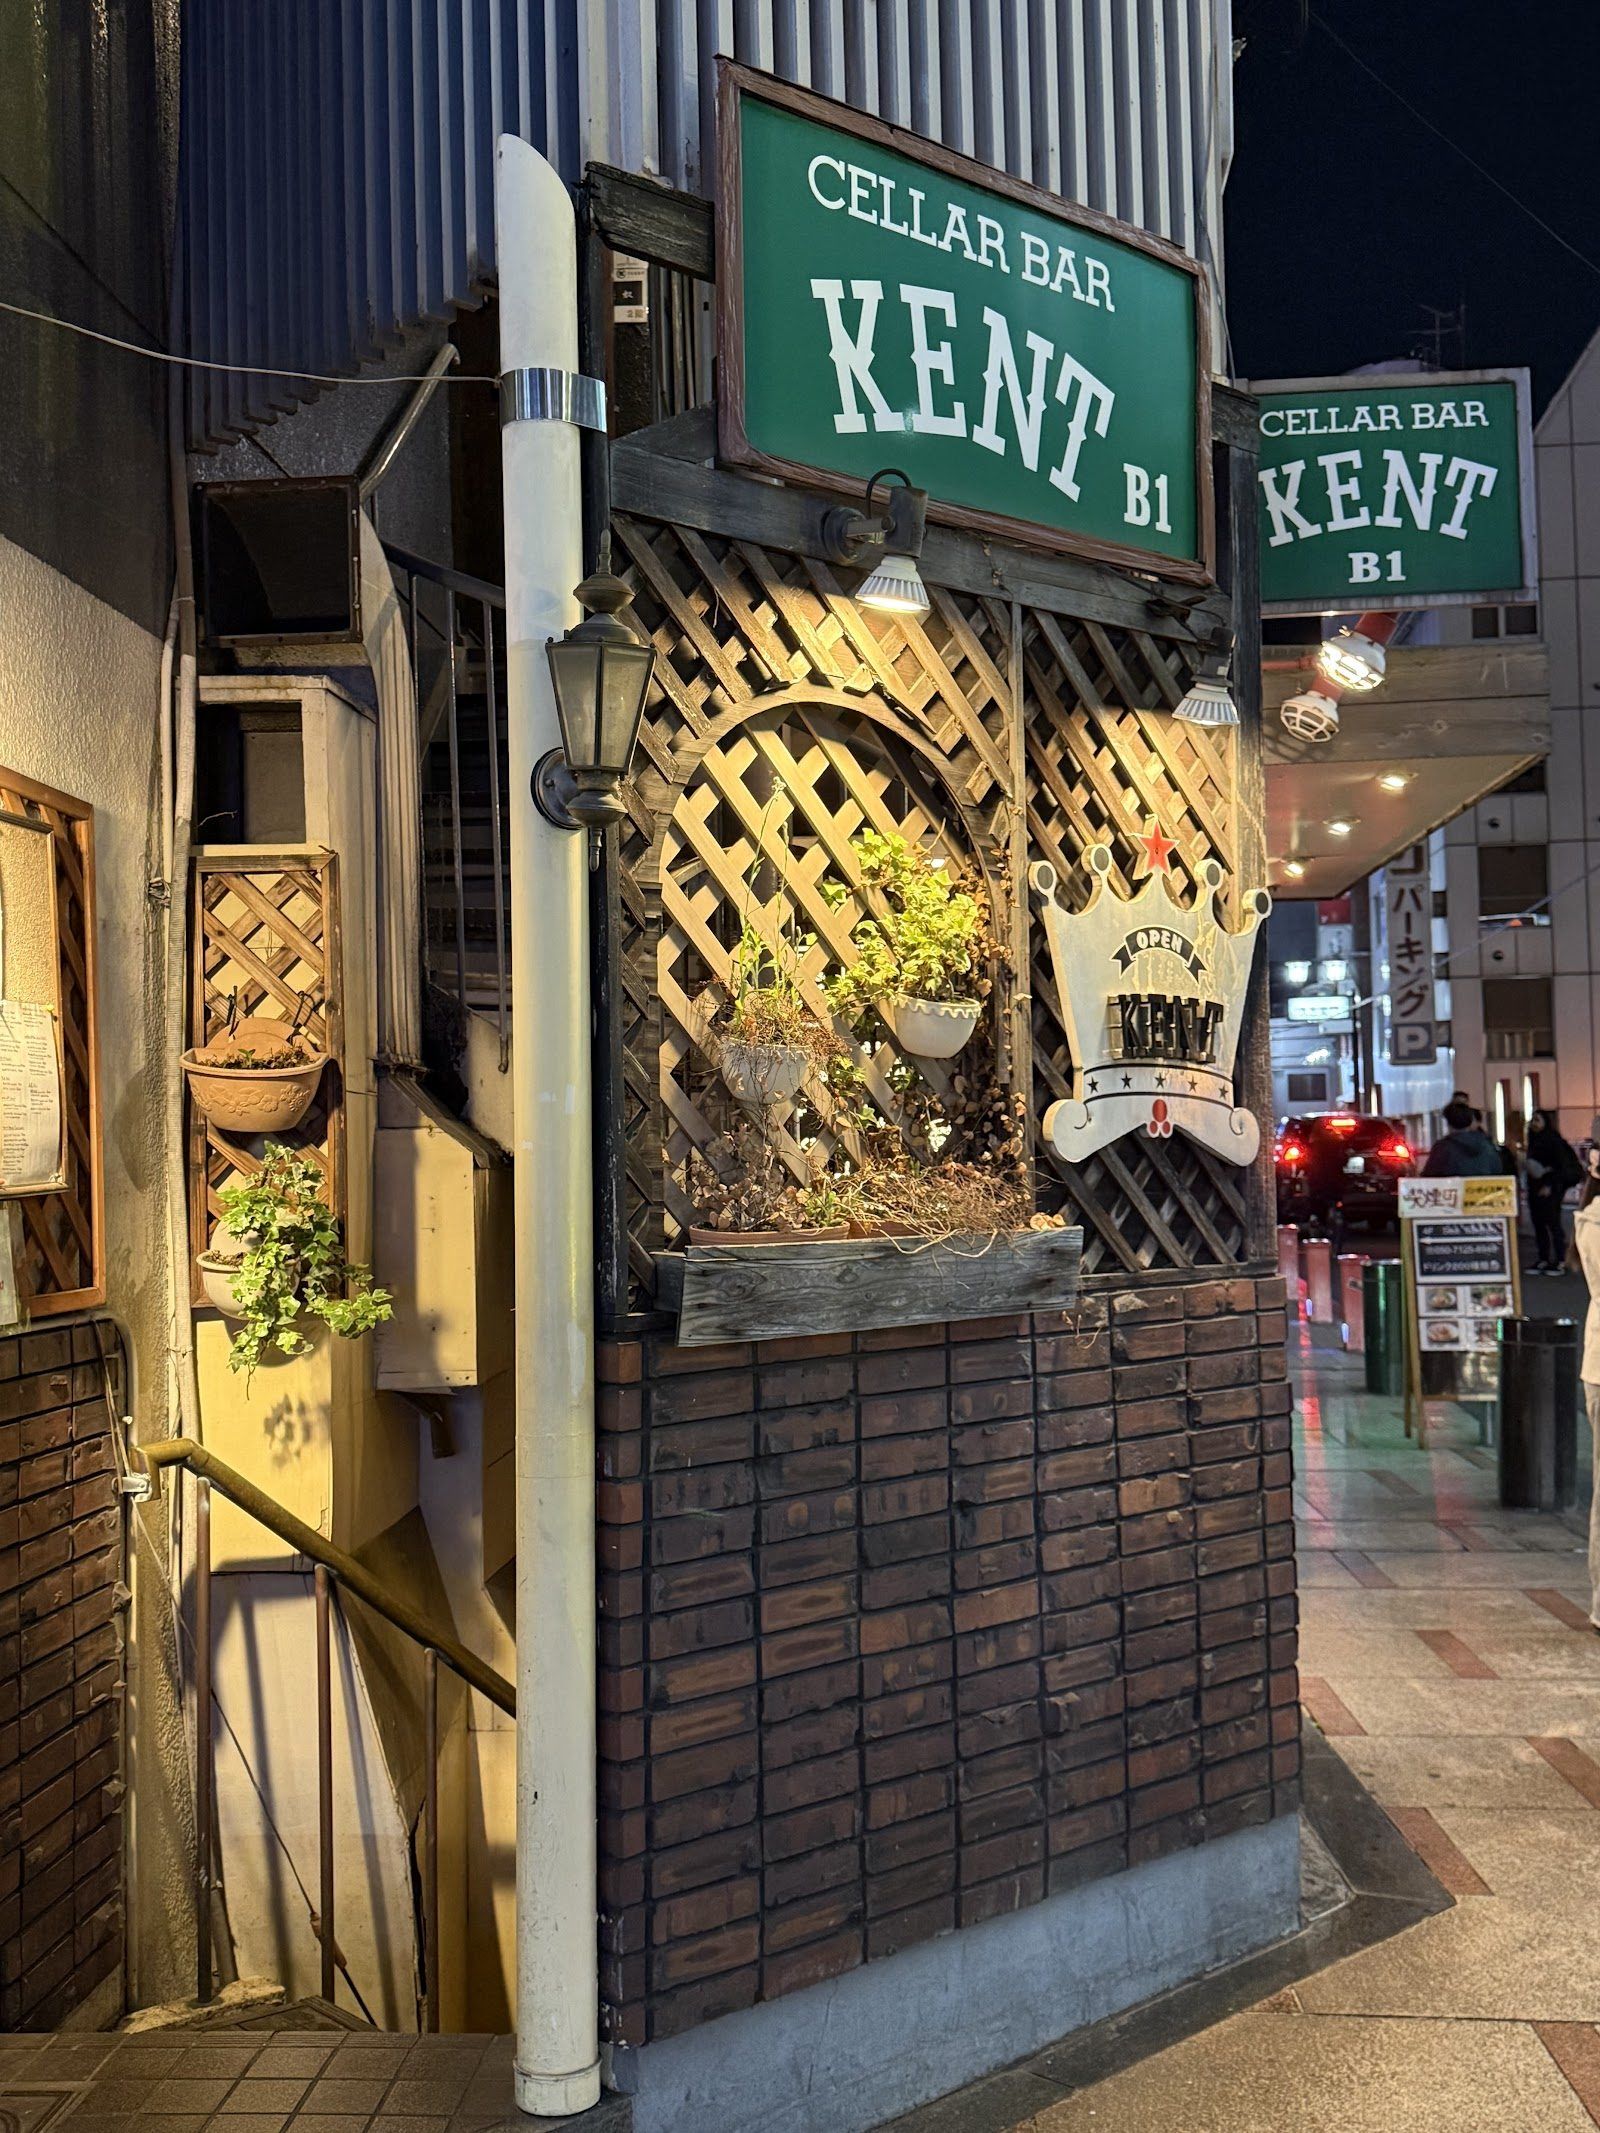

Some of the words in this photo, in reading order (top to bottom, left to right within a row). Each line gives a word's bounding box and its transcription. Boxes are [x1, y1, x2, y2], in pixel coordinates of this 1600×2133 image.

[808, 154, 1010, 274] CELLAR
[1020, 231, 1116, 313] BAR
[809, 278, 1116, 503] KENT
[1258, 404, 1403, 437] CELLAR
[1411, 400, 1490, 430] BAR
[1122, 462, 1173, 534] B1
[1257, 449, 1499, 548] KENT
[1348, 550, 1407, 584] B1
[1136, 929, 1183, 954] OPEN
[1108, 993, 1224, 1063] KENT
[1398, 1025, 1429, 1058] P
